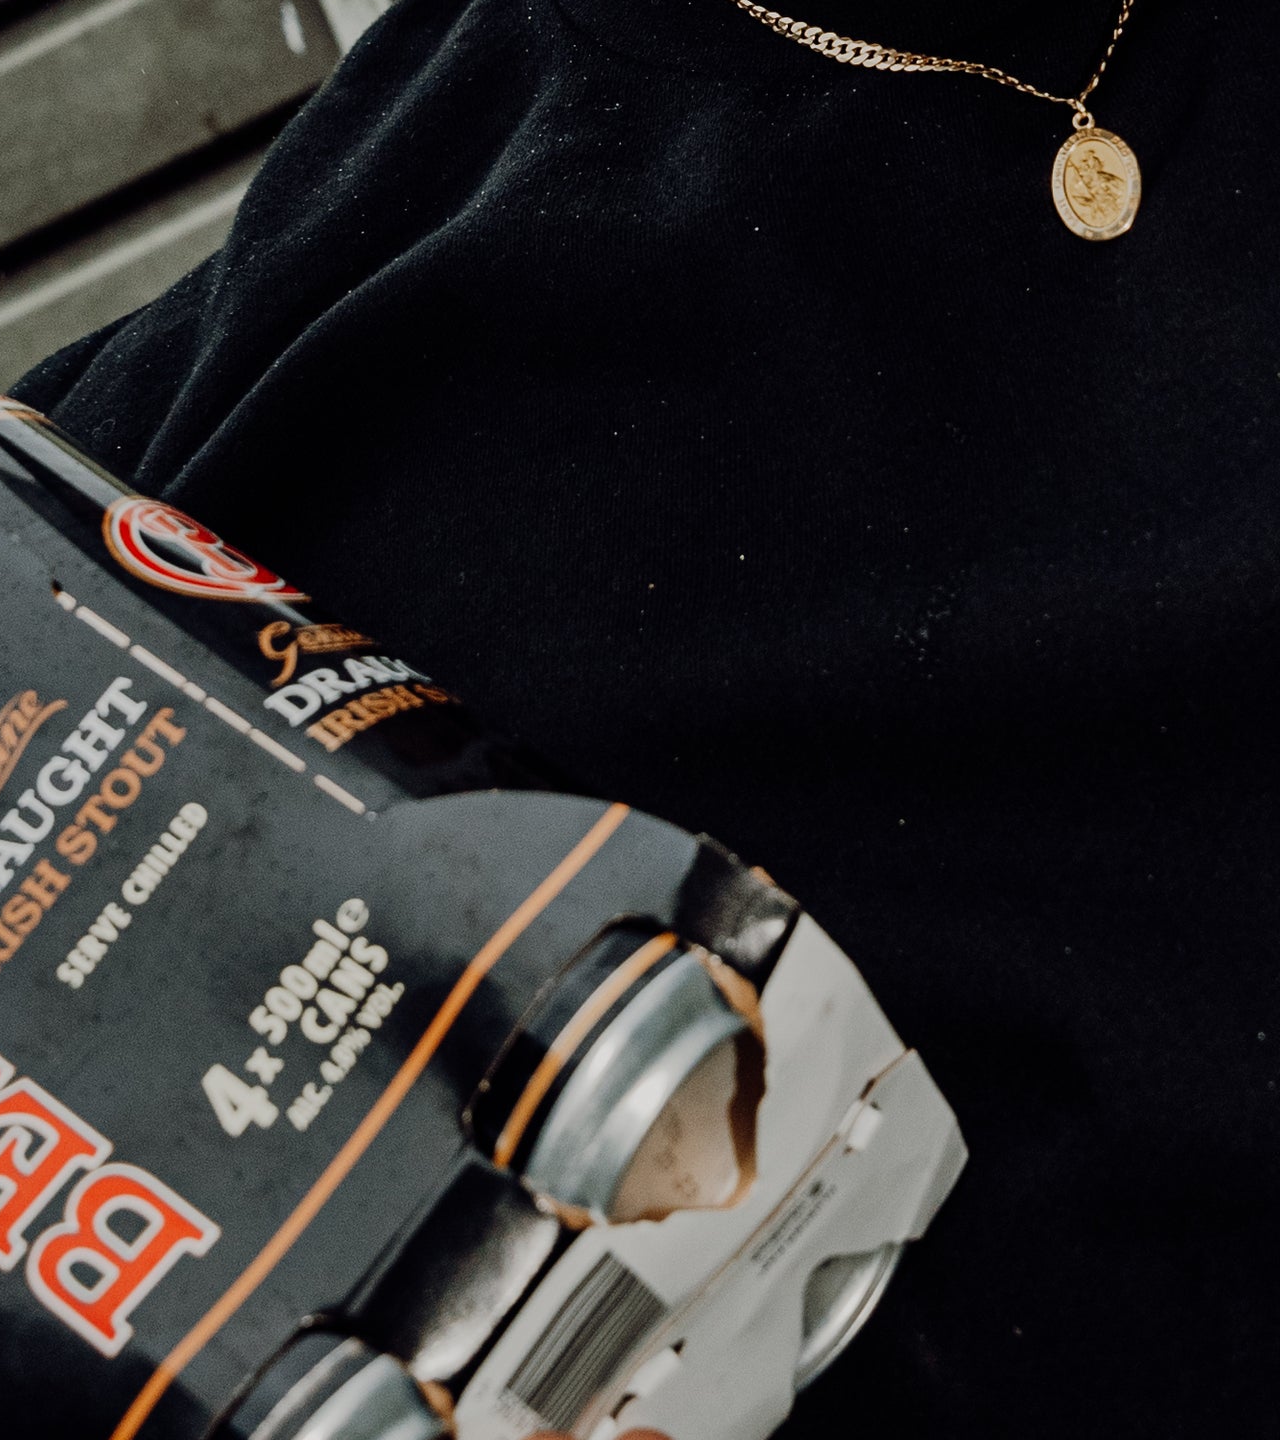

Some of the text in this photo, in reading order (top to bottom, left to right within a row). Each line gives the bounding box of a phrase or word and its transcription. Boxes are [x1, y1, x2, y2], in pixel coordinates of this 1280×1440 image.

[55, 707, 187, 865] STOUT
[56, 801, 209, 989] SERVE CHILLED
[301, 936, 389, 1044] CANS
